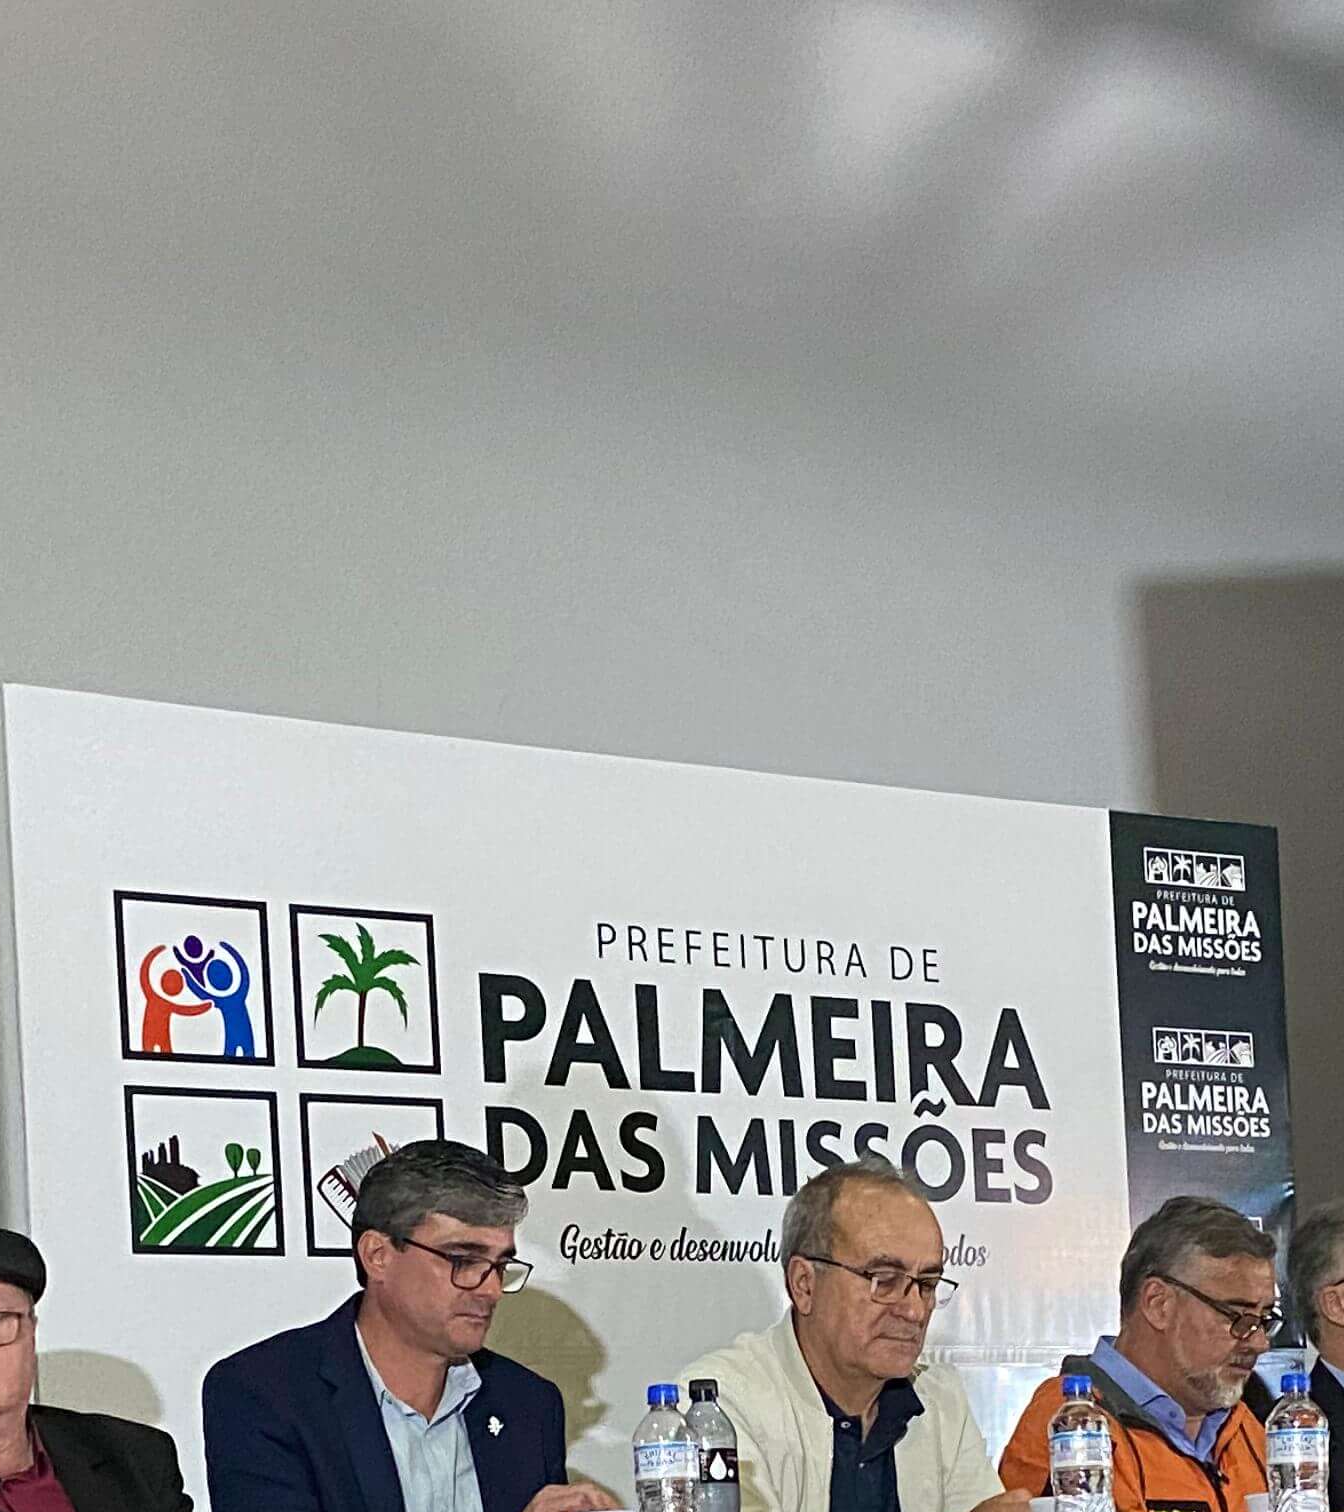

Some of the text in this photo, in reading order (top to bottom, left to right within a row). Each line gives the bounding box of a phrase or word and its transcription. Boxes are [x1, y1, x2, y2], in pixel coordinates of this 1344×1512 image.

[1132, 900, 1261, 938] PALMEIRA
[597, 922, 941, 983] PREFEITURA DE
[1133, 931, 1262, 962] DAS MISSÕES
[477, 972, 1051, 1111] PALMEIRA
[1141, 1081, 1270, 1114] PALMEIRA
[1143, 1110, 1271, 1138] DAS MISSÕES
[485, 1104, 666, 1194] DAS
[560, 1223, 988, 1267] Gestão e desenvolv odos
